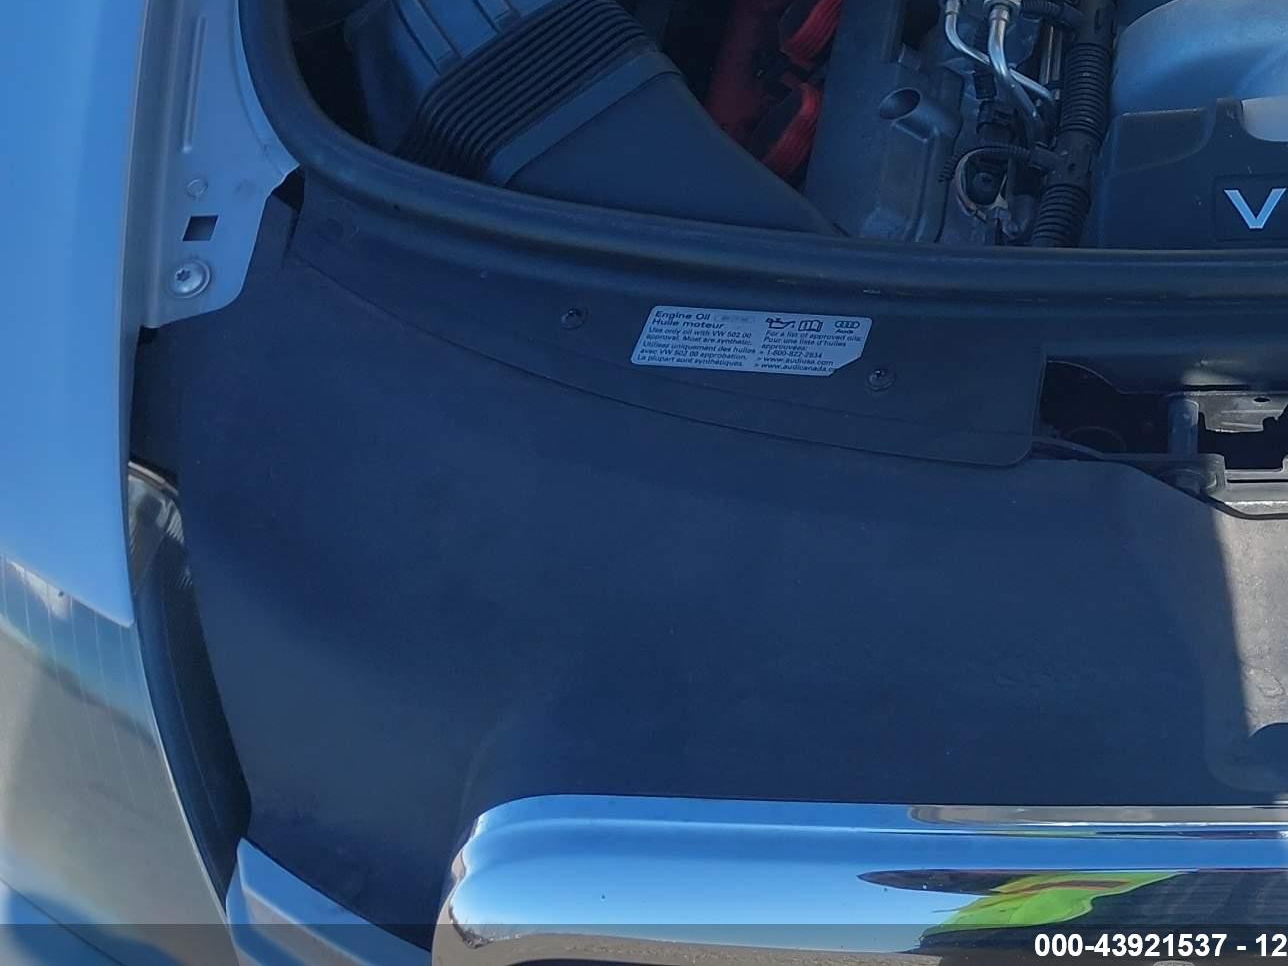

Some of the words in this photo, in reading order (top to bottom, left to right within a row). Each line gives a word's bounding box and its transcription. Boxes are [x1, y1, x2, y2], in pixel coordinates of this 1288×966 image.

[655, 310, 692, 320] Engine
[652, 318, 679, 326] Huile
[683, 321, 724, 329] moteur
[671, 343, 716, 353] uniquement
[648, 355, 675, 363] plupart
[763, 357, 834, 365] www.audiusa.com
